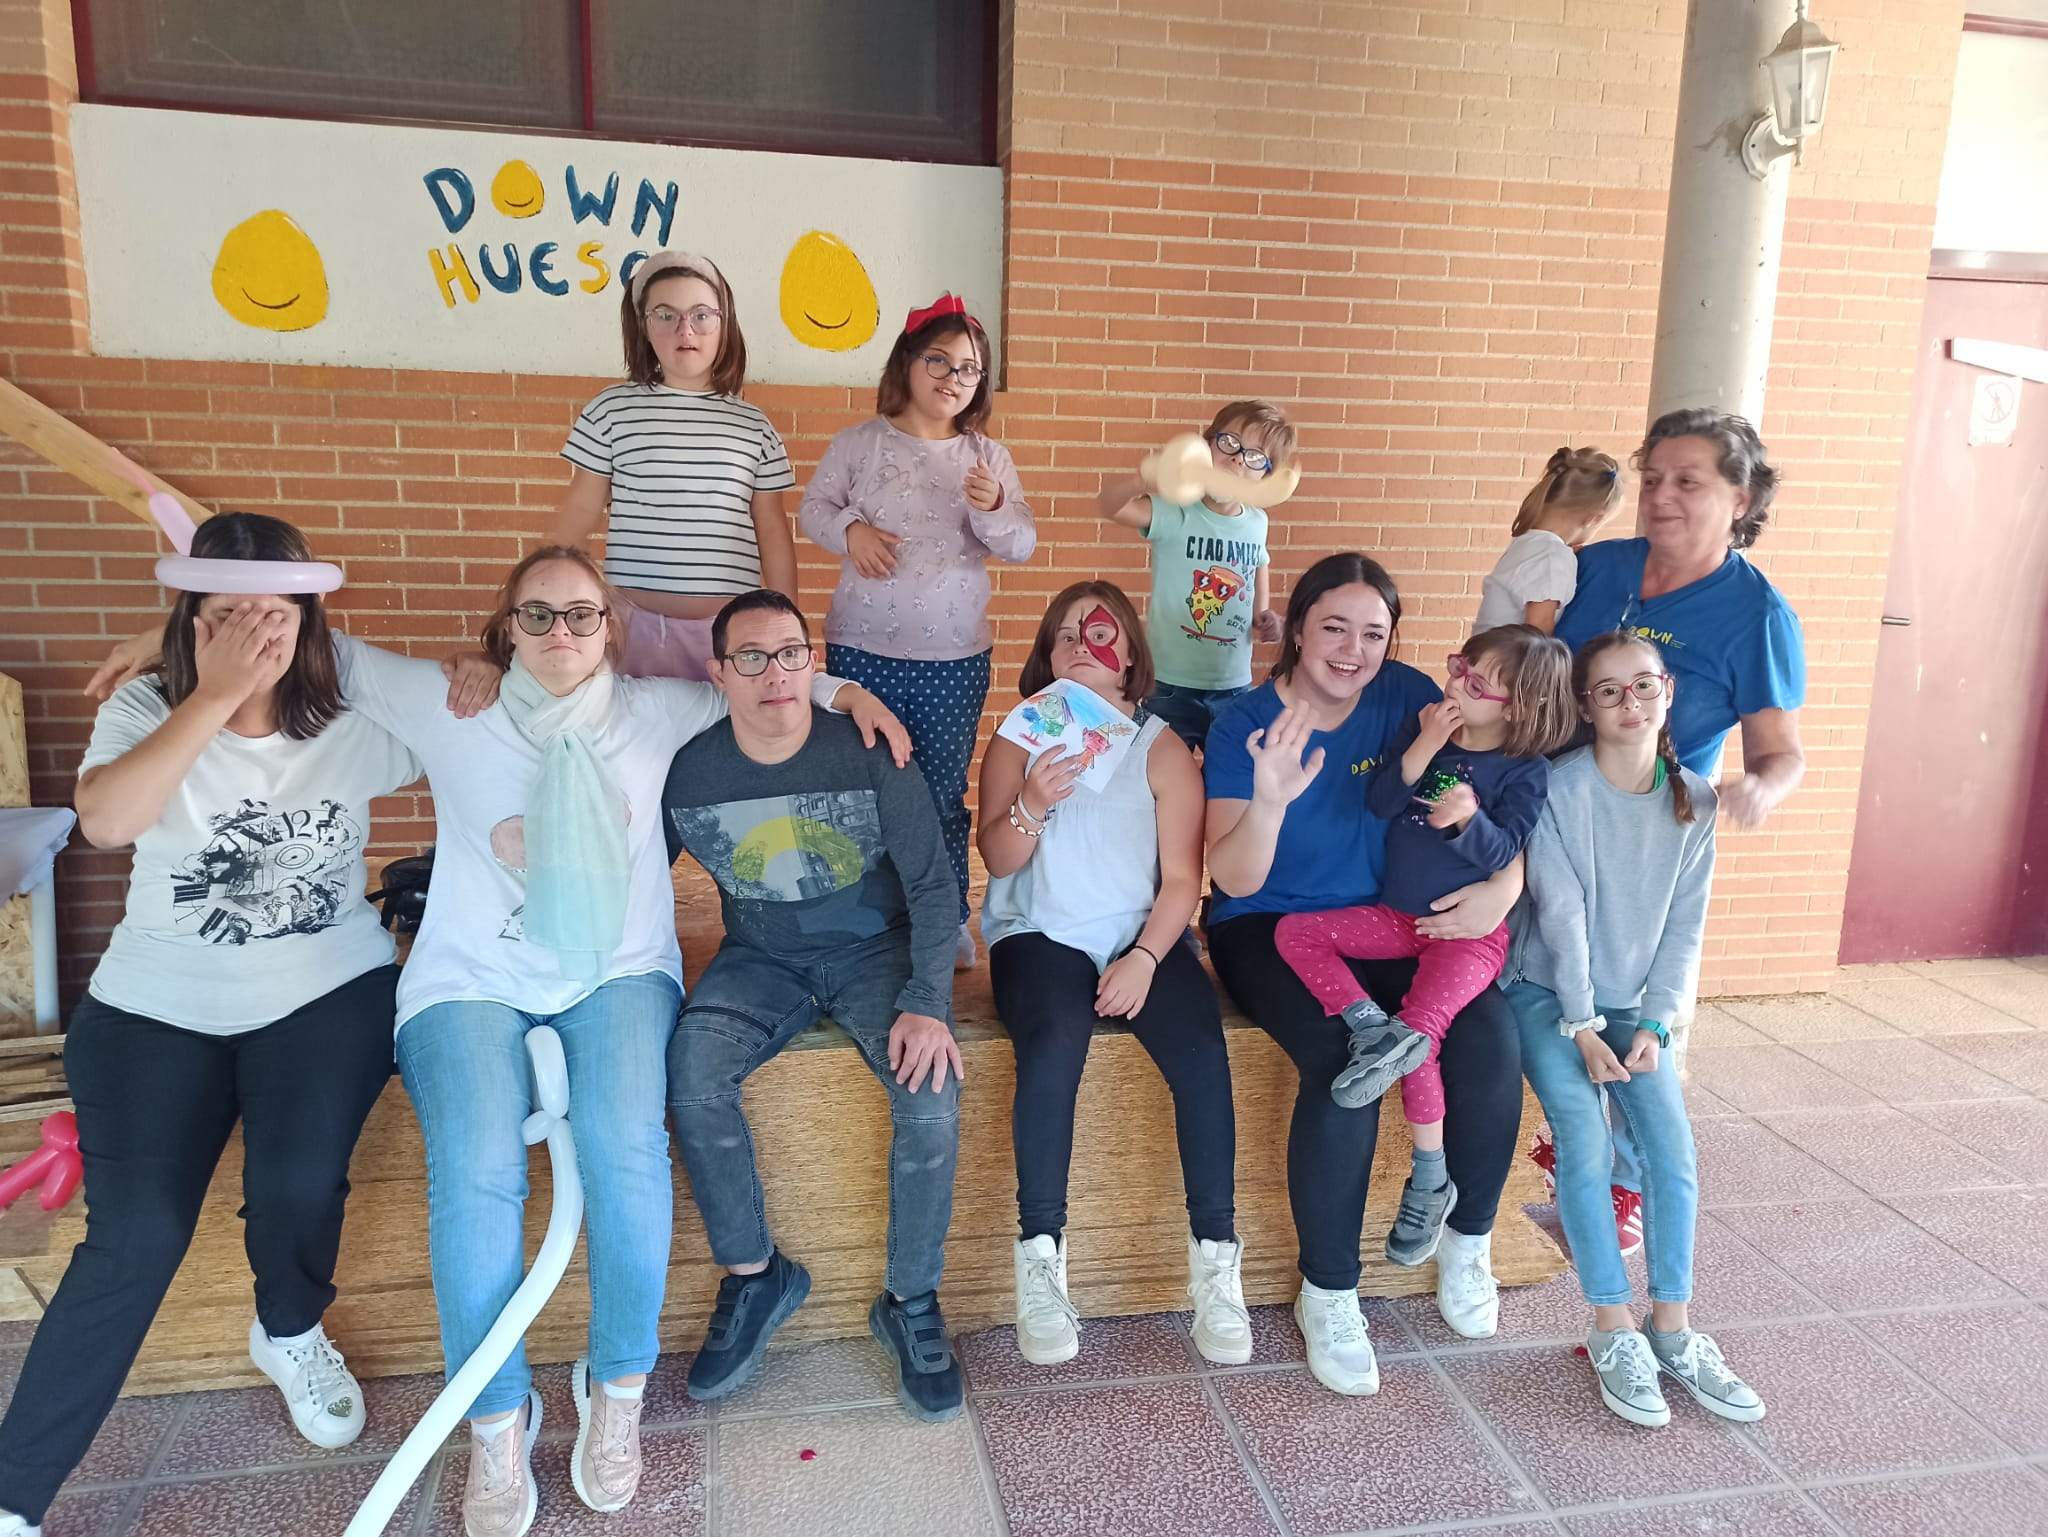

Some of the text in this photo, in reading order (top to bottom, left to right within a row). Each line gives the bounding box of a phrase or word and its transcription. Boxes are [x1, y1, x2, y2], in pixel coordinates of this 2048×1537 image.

[423, 160, 679, 247] DOWN
[427, 241, 650, 309] HUESC
[1186, 536, 1223, 562] CIAO
[281, 809, 312, 839] 12
